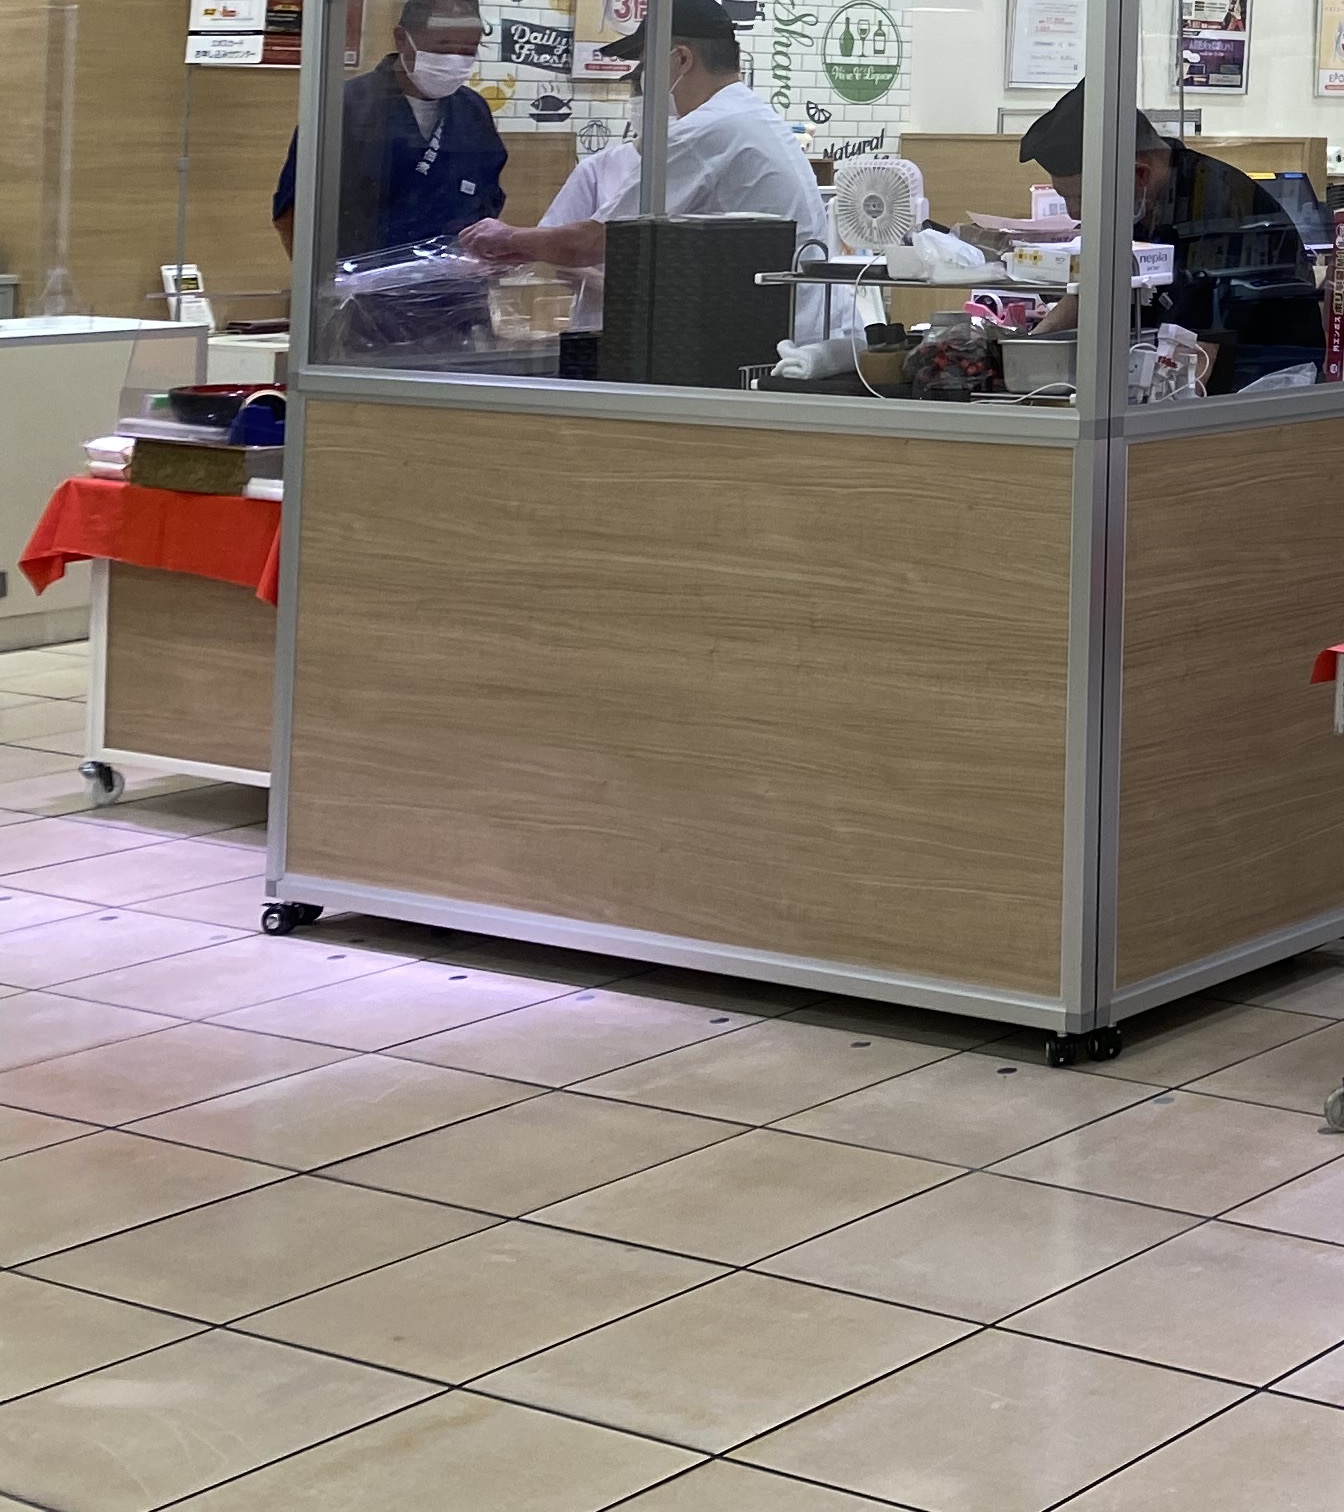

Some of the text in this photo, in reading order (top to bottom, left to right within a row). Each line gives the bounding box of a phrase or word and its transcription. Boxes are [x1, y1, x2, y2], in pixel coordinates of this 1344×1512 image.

[510, 23, 570, 55] Daily
[822, 127, 886, 161] Natural
[1139, 251, 1168, 265] nepia
